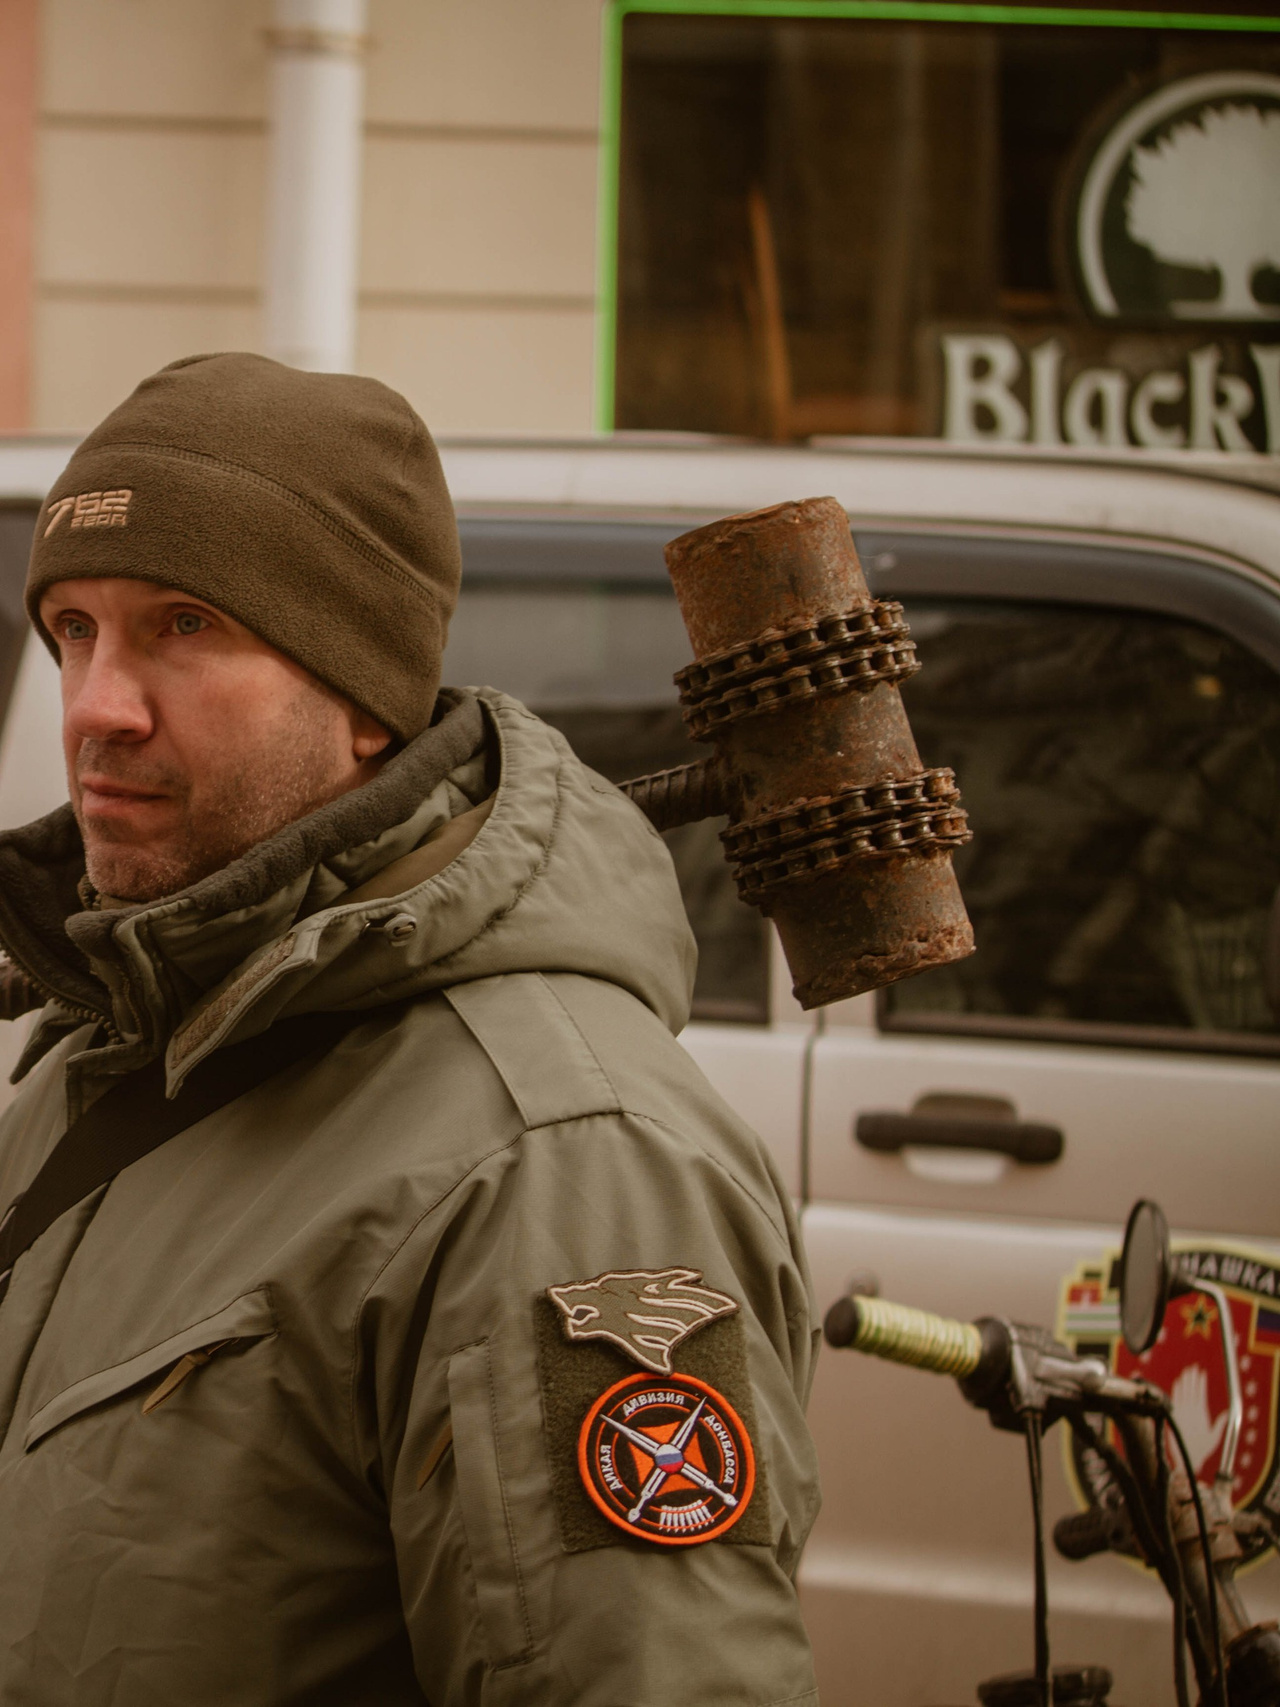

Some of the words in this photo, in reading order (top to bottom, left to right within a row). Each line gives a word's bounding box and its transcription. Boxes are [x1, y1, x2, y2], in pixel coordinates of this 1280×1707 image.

[600, 1444, 624, 1491] ДИКАЯ
[622, 1391, 685, 1417] ДИВИЗИЯ
[704, 1414, 736, 1485] ДОНБАССА
